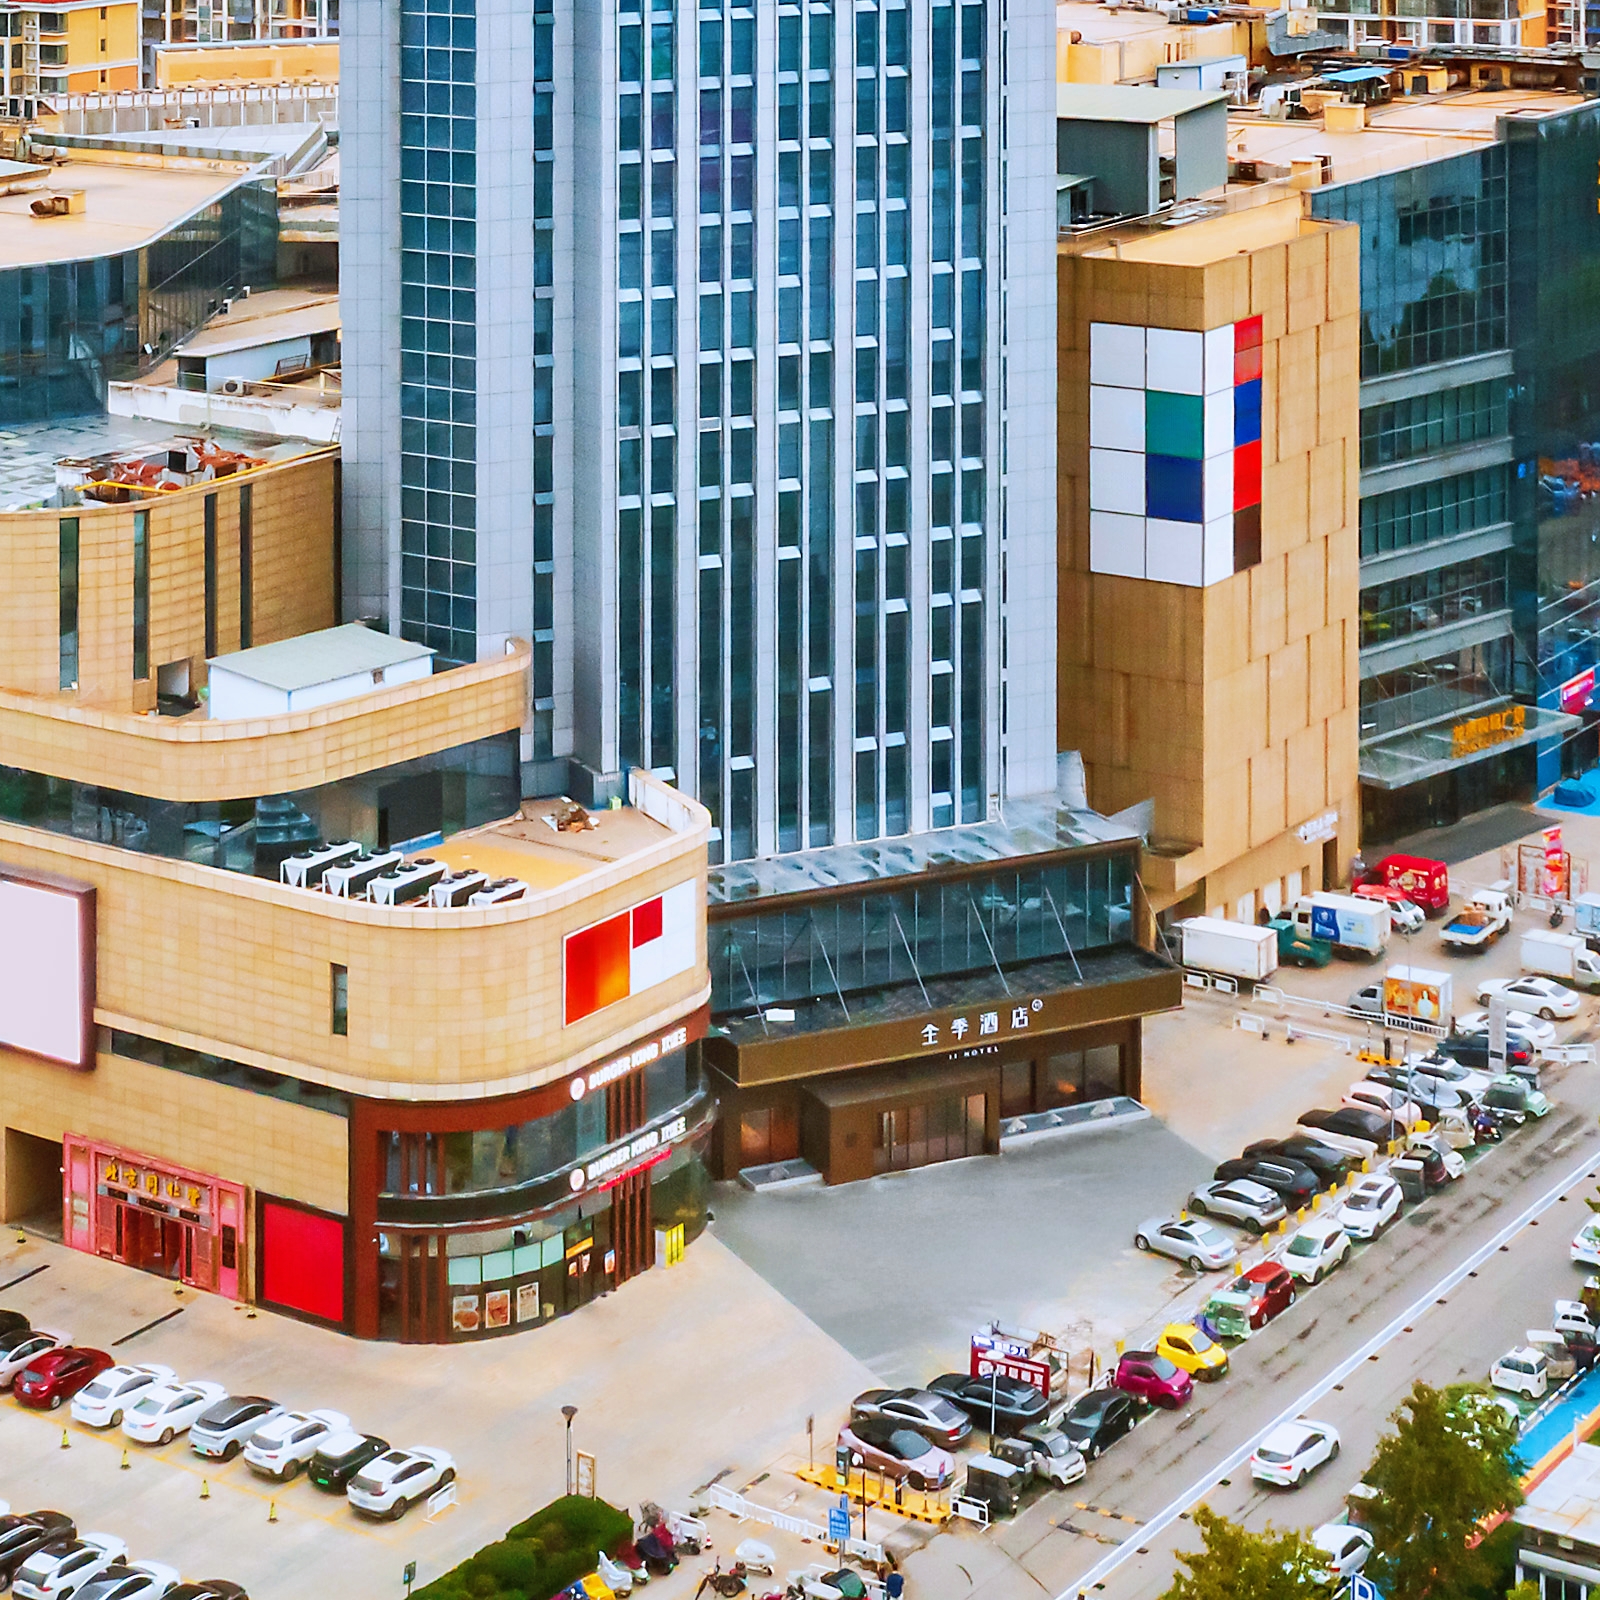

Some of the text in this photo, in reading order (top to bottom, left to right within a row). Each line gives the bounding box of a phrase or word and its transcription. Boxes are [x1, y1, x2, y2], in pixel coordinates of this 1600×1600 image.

[921, 1006, 1029, 1046] 全季酒店
[588, 1056, 631, 1090] BURGER
[631, 1042, 659, 1068] KING
[963, 1045, 999, 1057] HOTEL
[587, 1145, 630, 1180] BURGER
[630, 1130, 658, 1158] KING
